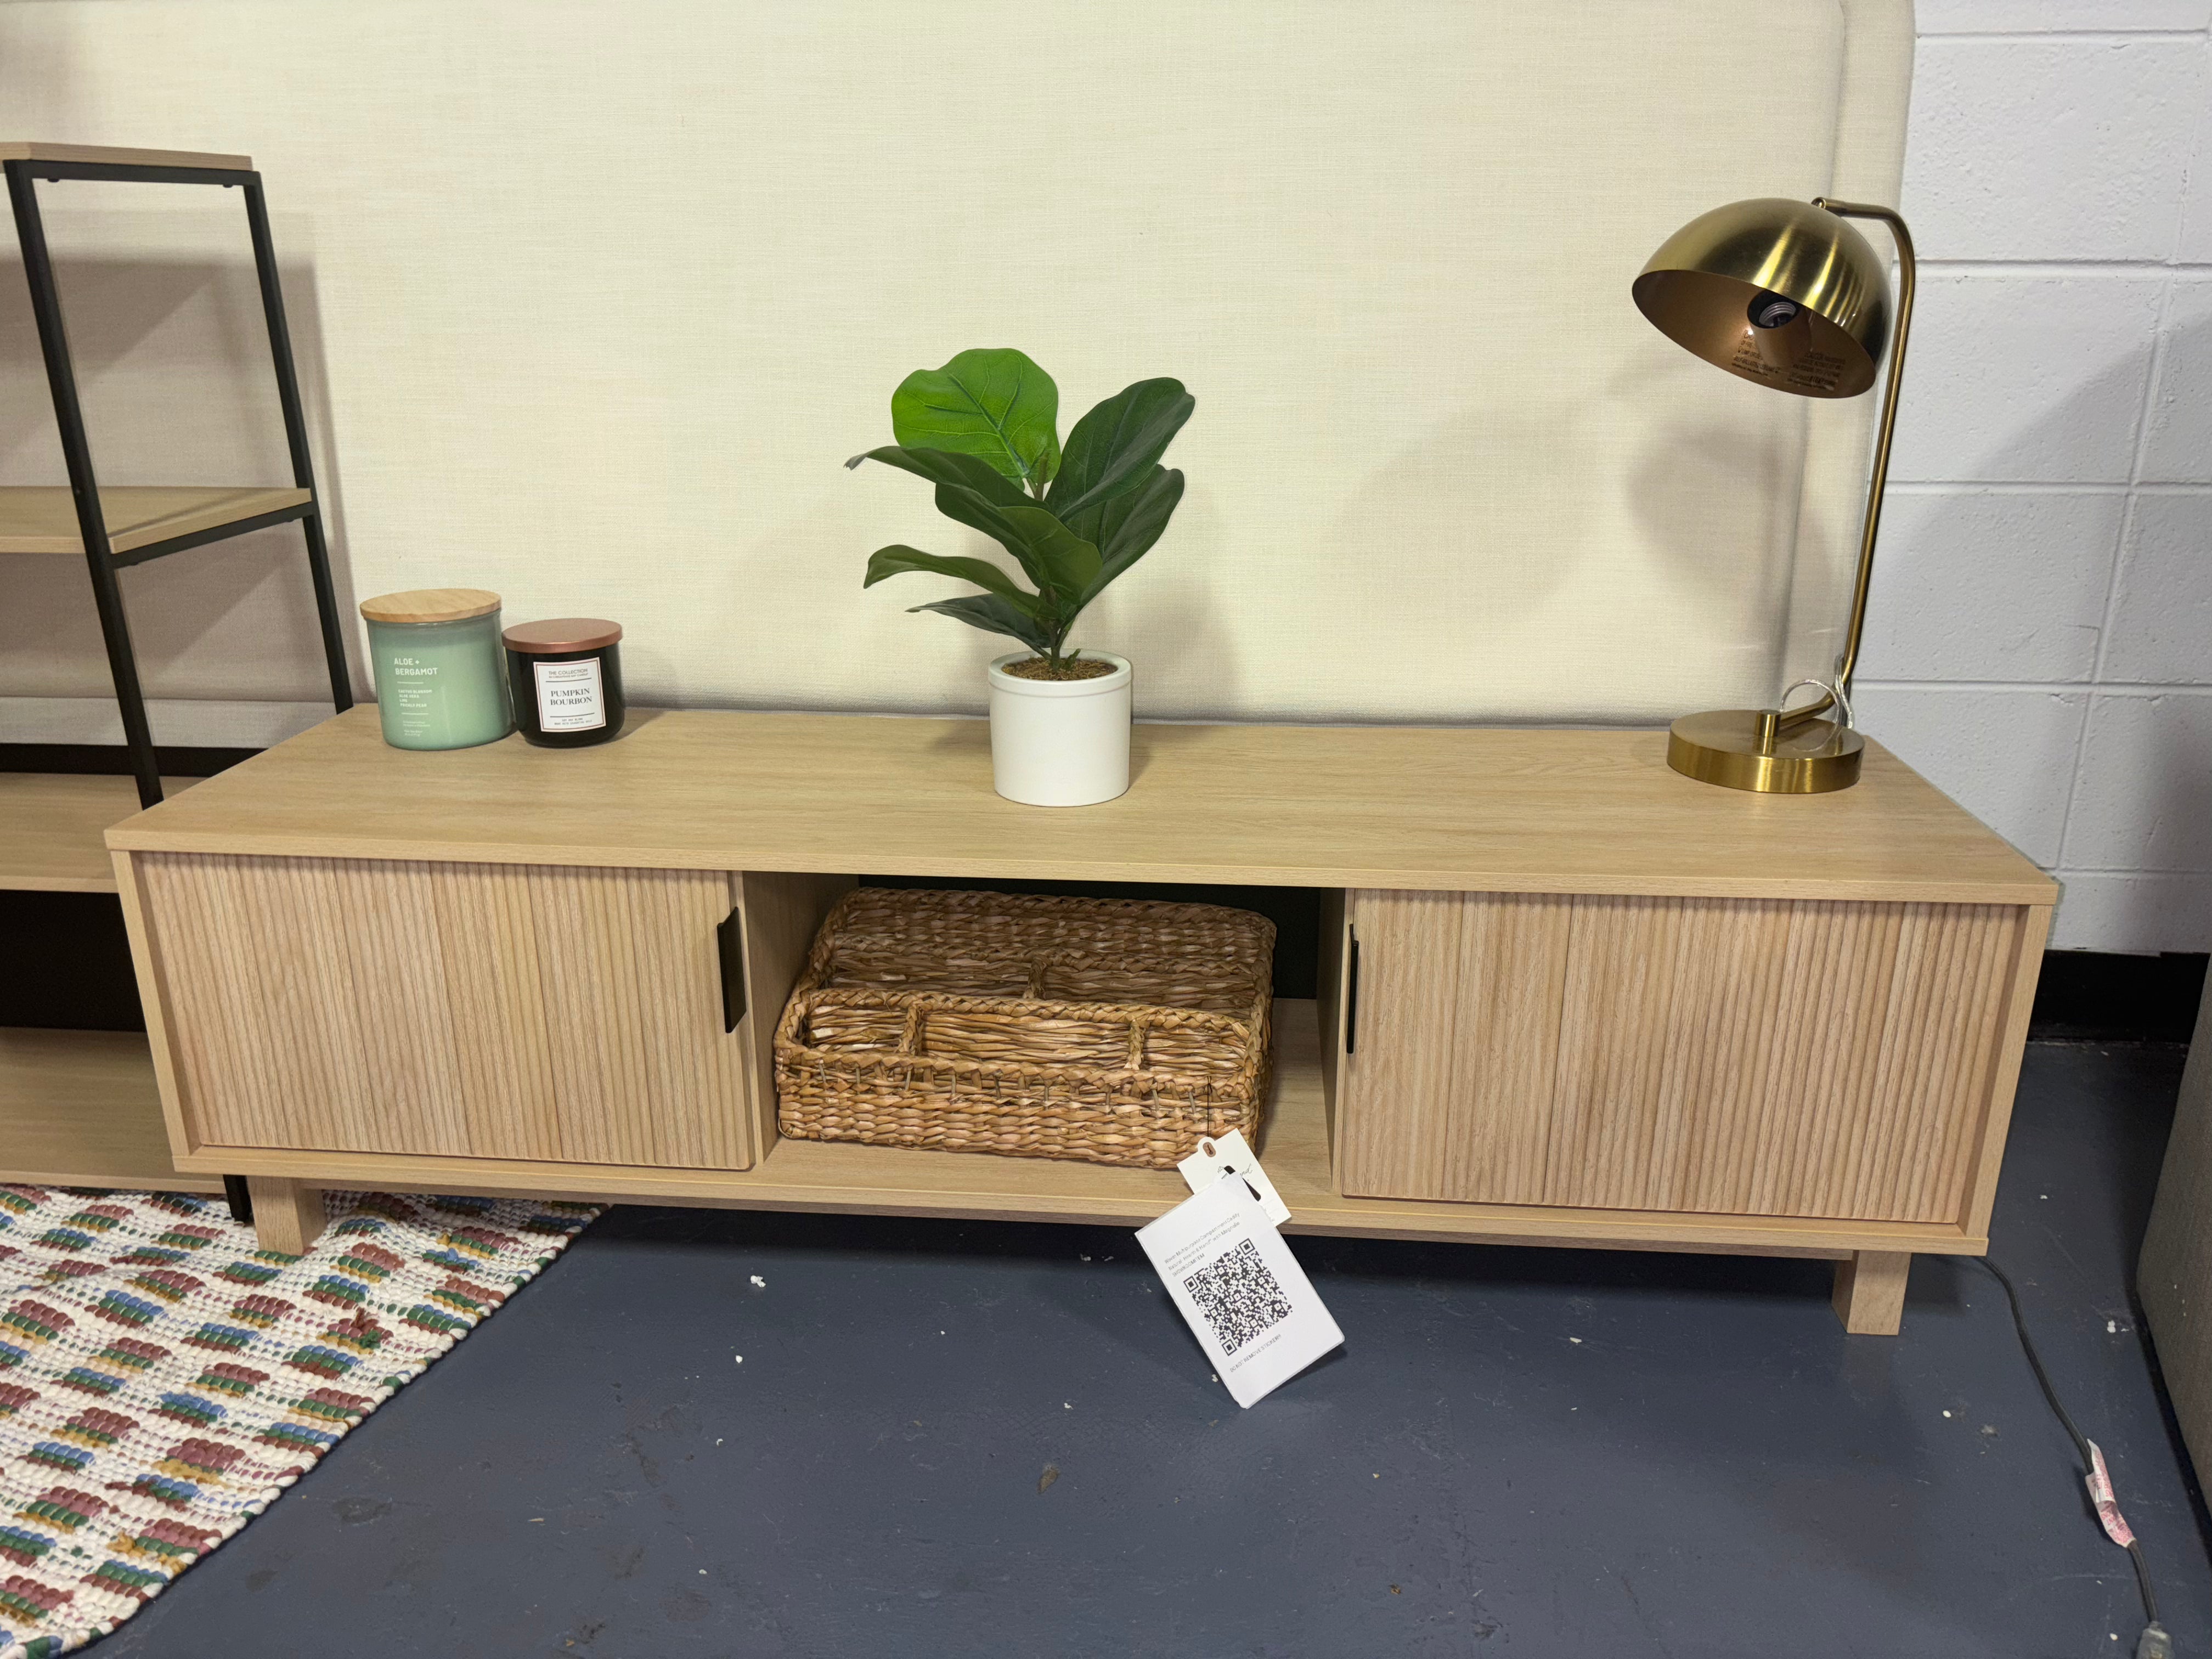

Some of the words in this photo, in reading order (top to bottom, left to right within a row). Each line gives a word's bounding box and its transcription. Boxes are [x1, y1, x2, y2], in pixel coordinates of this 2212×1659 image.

[395, 667, 438, 676] BERGAMOT
[551, 687, 590, 697] PUMPKIN
[550, 696, 592, 706] BOURBON
[1235, 1361, 1244, 1369] NOT
[1243, 1347, 1262, 1363] REMOVE
